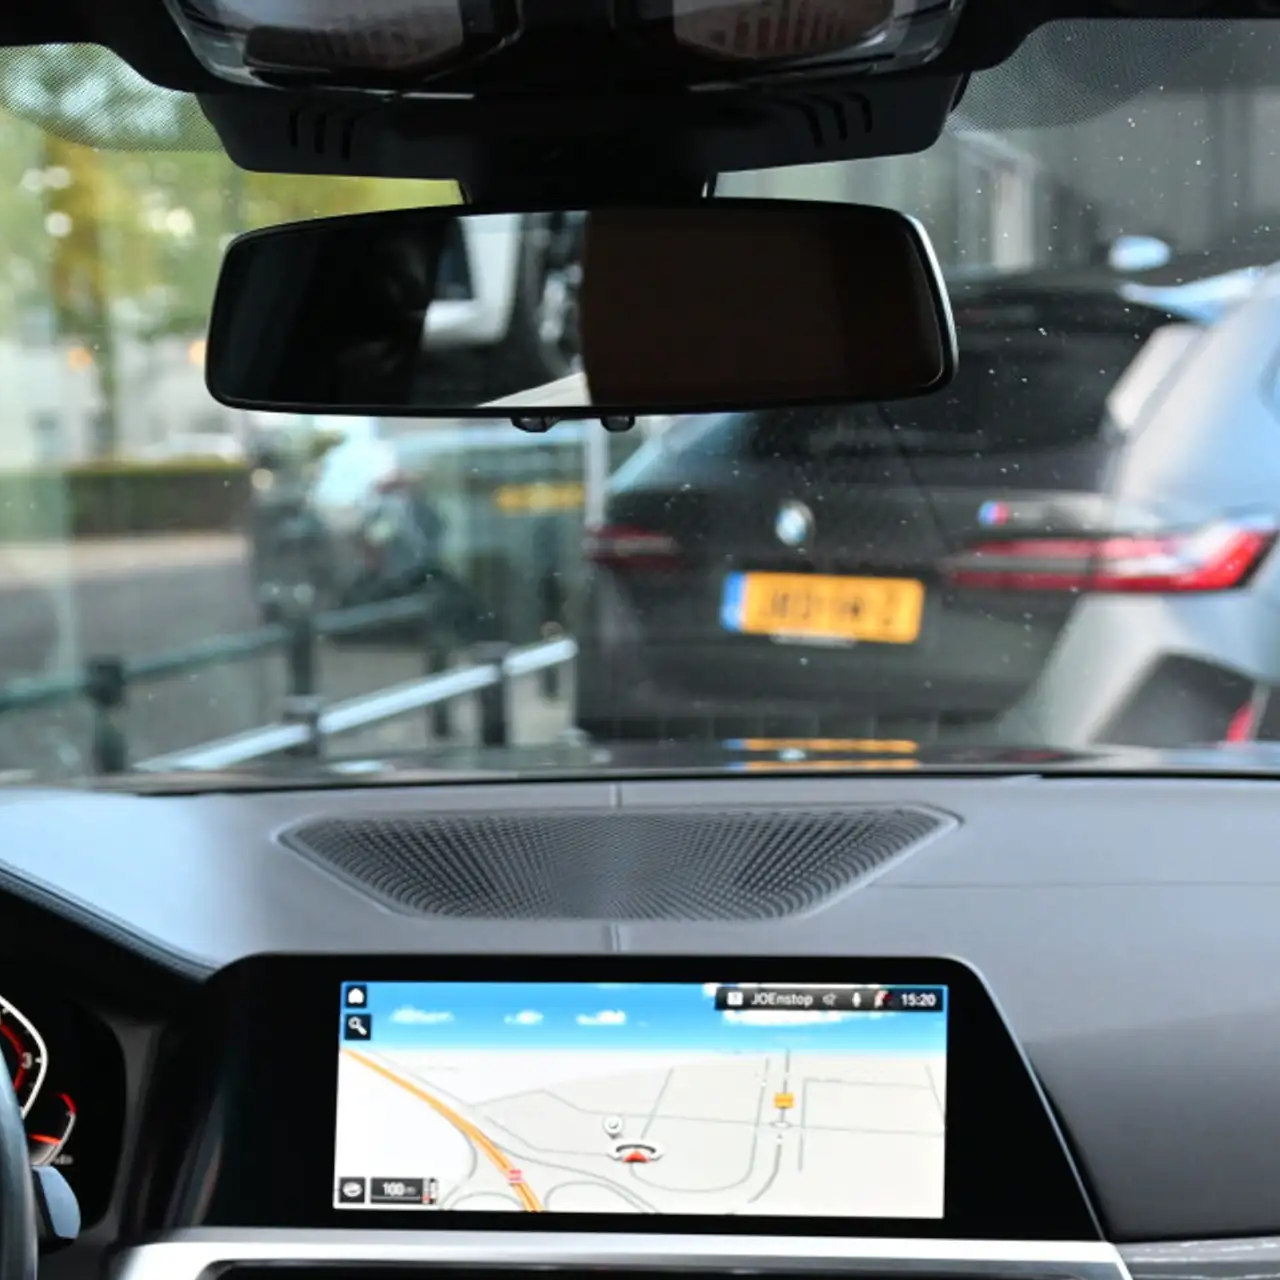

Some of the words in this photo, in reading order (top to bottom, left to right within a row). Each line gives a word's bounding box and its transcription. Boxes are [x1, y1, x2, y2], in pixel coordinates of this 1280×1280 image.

[751, 992, 813, 1008] JOEnstop
[900, 993, 936, 1007] 15:20
[22, 1052, 33, 1069] 3
